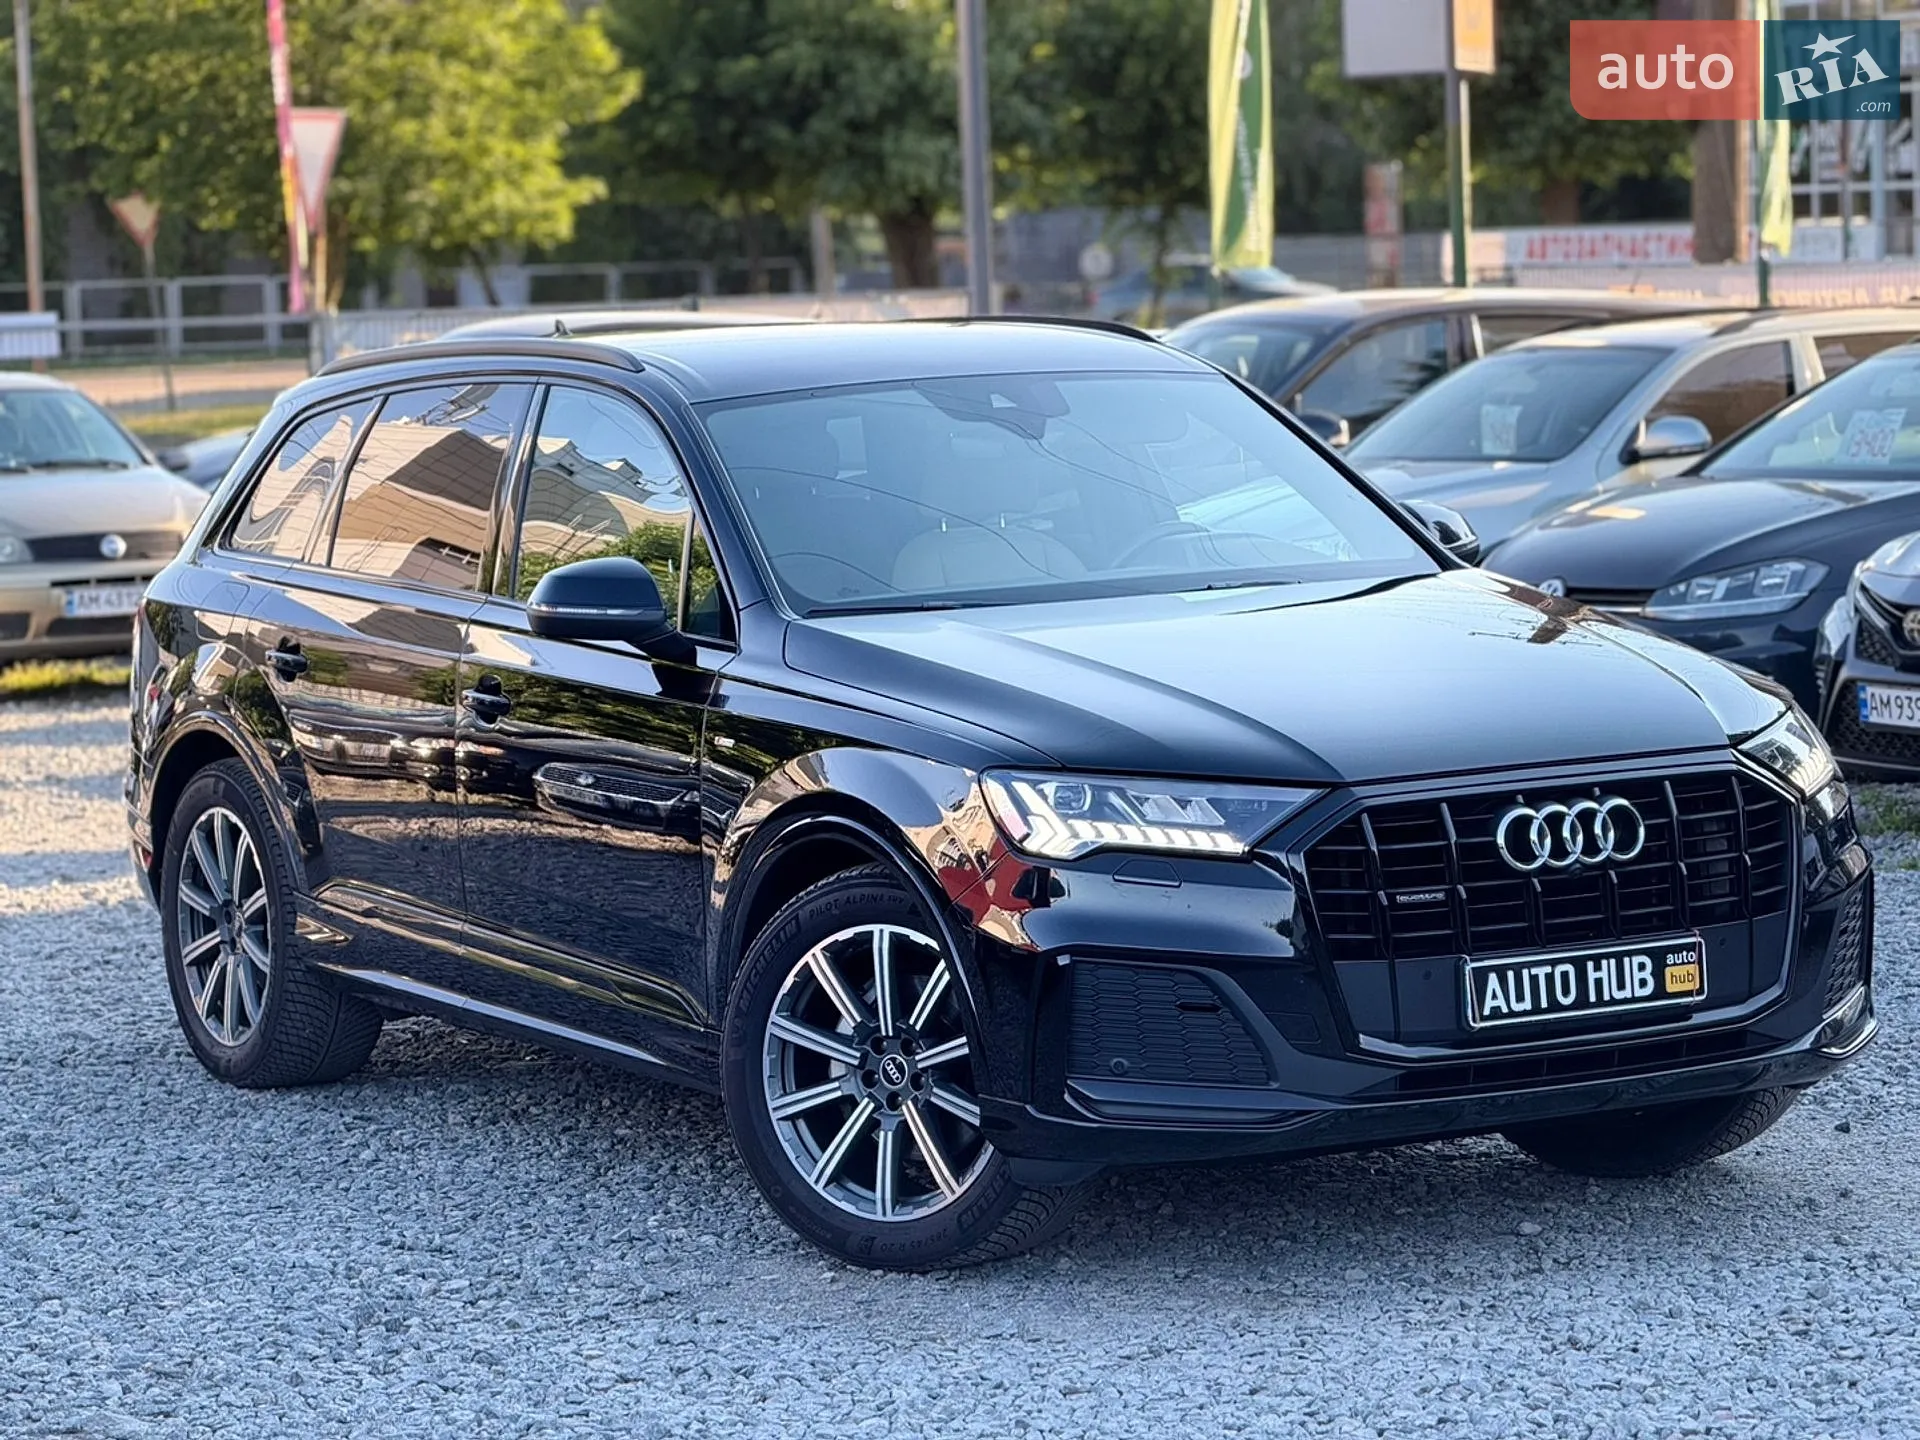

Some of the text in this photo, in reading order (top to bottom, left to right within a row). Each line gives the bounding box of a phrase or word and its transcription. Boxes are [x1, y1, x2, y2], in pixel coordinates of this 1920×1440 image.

[808, 898, 840, 920] PILOT
[1666, 951, 1696, 965] auto
[1483, 955, 1655, 1016] AUTO HUB
[1670, 970, 1696, 985] hub
